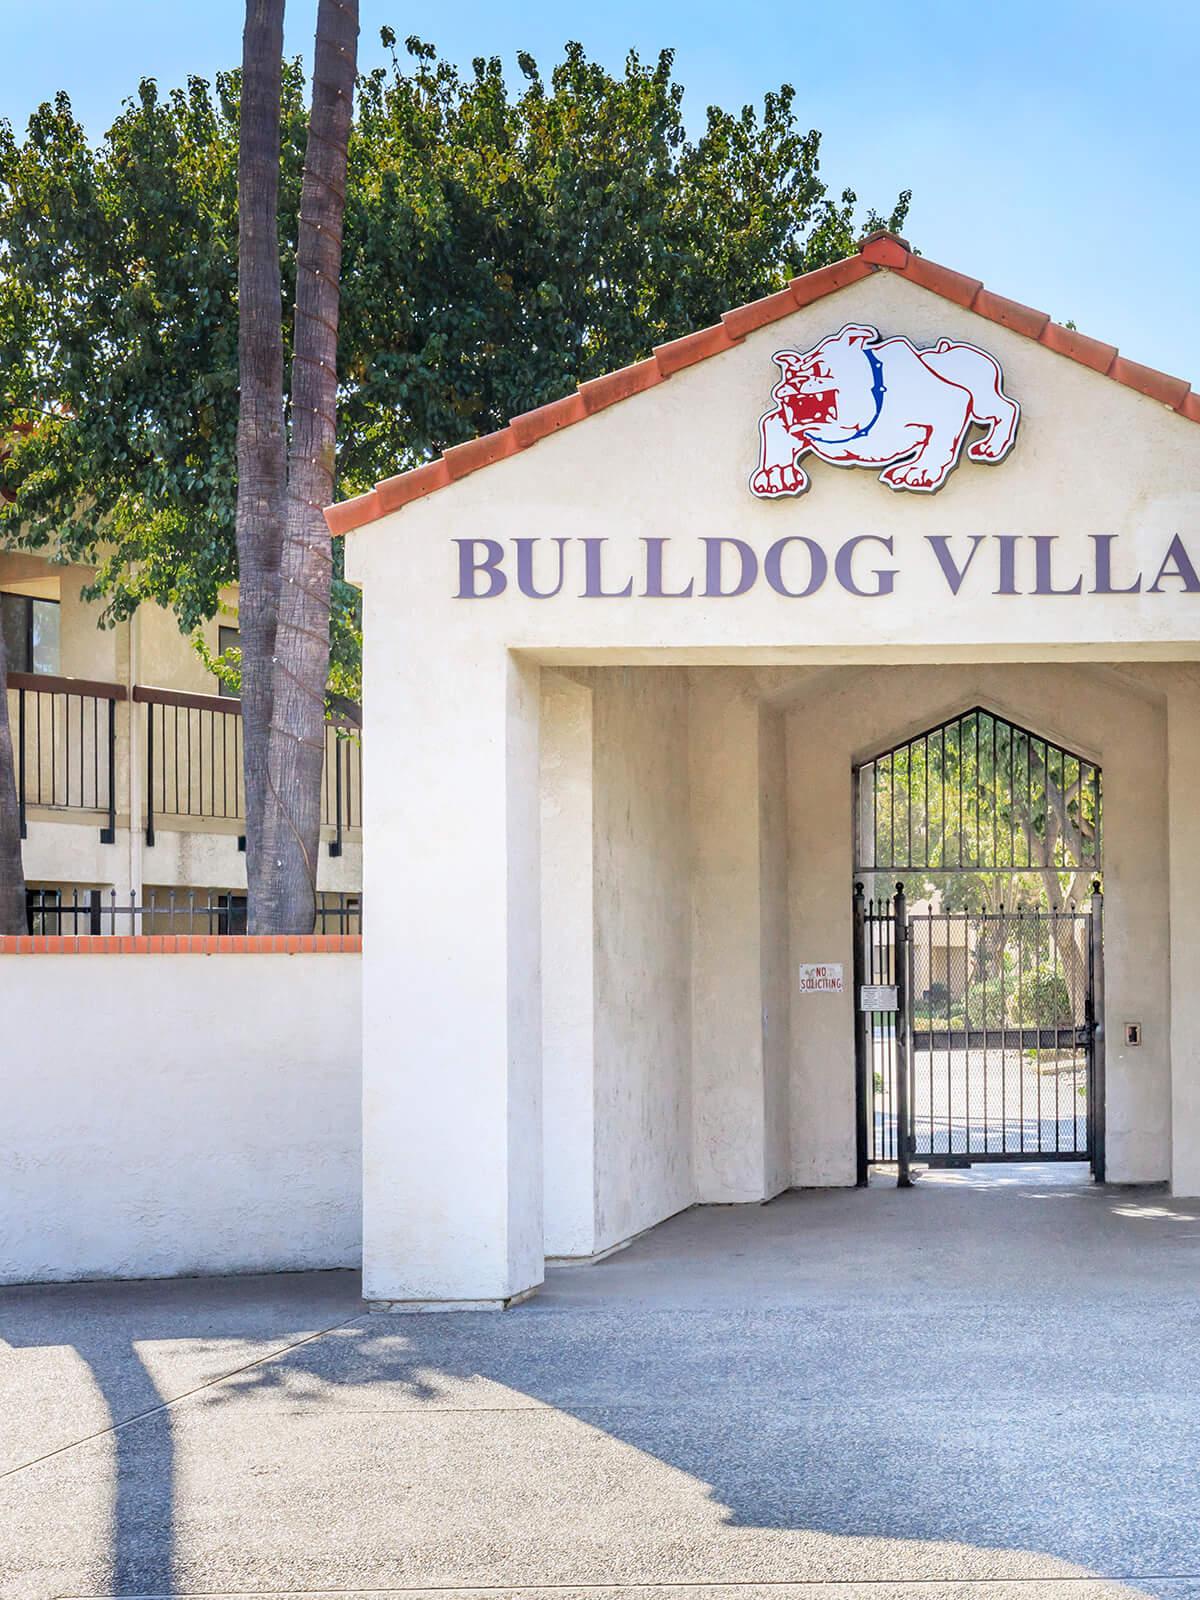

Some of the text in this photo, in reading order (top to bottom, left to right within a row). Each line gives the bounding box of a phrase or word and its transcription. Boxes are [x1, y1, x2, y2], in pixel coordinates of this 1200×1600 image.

[450, 534, 901, 600] BULLDOG
[815, 966, 827, 977] NO
[800, 978, 842, 989] SOLICITING
